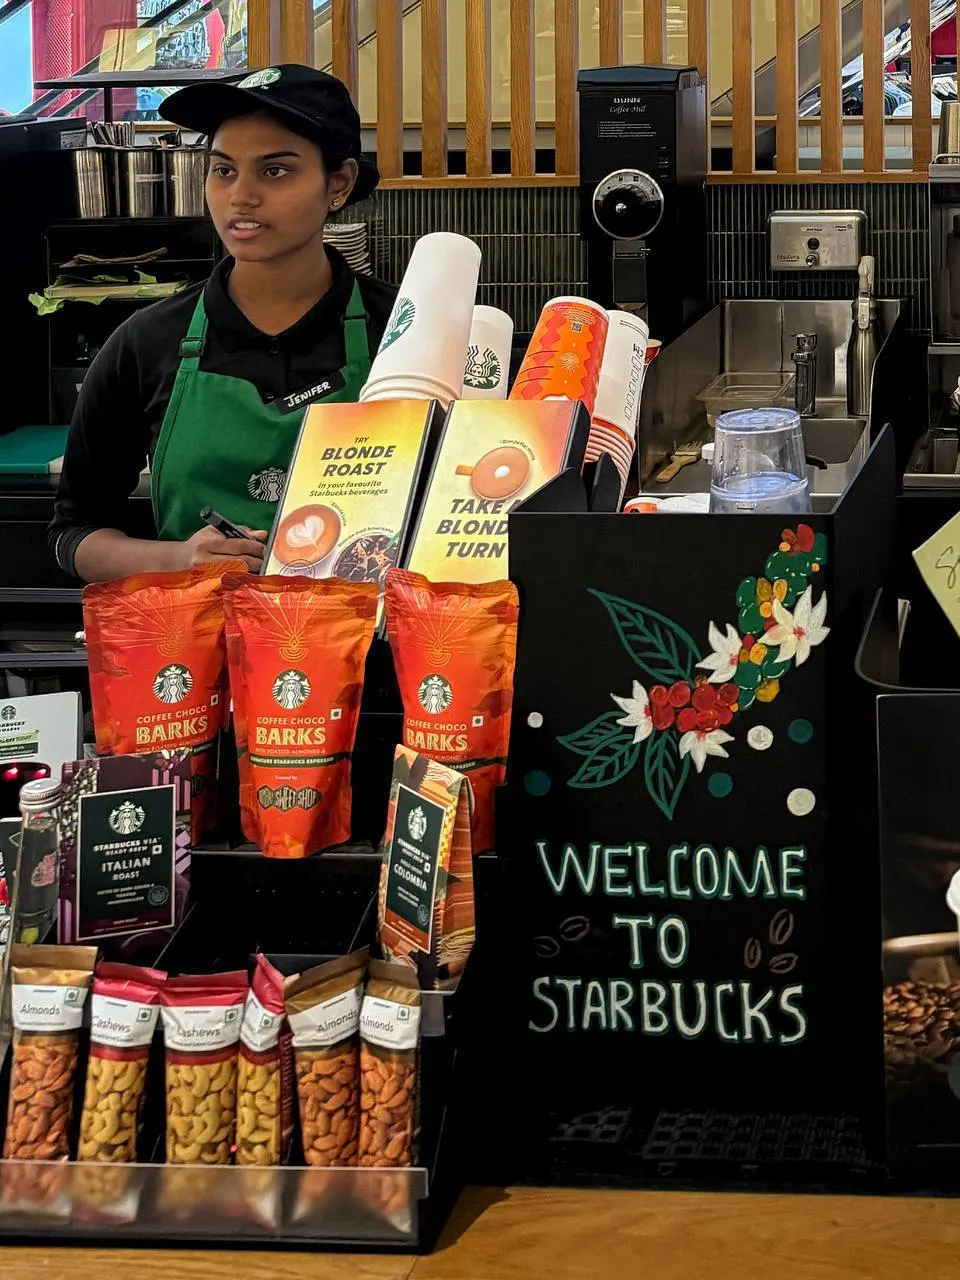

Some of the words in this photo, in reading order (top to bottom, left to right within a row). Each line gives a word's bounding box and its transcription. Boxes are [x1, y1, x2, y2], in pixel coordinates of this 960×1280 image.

[283, 381, 331, 408] JENIFER
[321, 445, 396, 460] BLONDE
[323, 462, 387, 477] ROAST
[346, 480, 381, 488] favourite
[450, 499, 506, 514] TAKE
[436, 519, 508, 535] BLOND
[446, 542, 506, 558] TURN
[137, 712, 173, 724] COFFEE
[176, 705, 207, 719] CHOCO
[257, 717, 288, 725] COFFEE
[291, 717, 325, 725] CHOCO
[136, 716, 208, 745] BARKS
[406, 718, 432, 730] COFFEE
[434, 723, 467, 731] CHOCO
[255, 727, 326, 745] BARKS
[406, 729, 468, 751] BARKS
[93, 840, 140, 852] STARBUCKS
[102, 857, 151, 872] ITALIAN
[536, 840, 807, 901] WELCOME
[112, 871, 140, 880] ROAST
[394, 863, 427, 892] COLOMBIA
[613, 914, 689, 967] TO
[20, 1004, 60, 1015] Almonds
[528, 976, 808, 1044] STARBUCKS
[92, 1015, 131, 1033] Cashews
[317, 1008, 357, 1033] Almonds
[361, 1015, 394, 1033] Almonds
